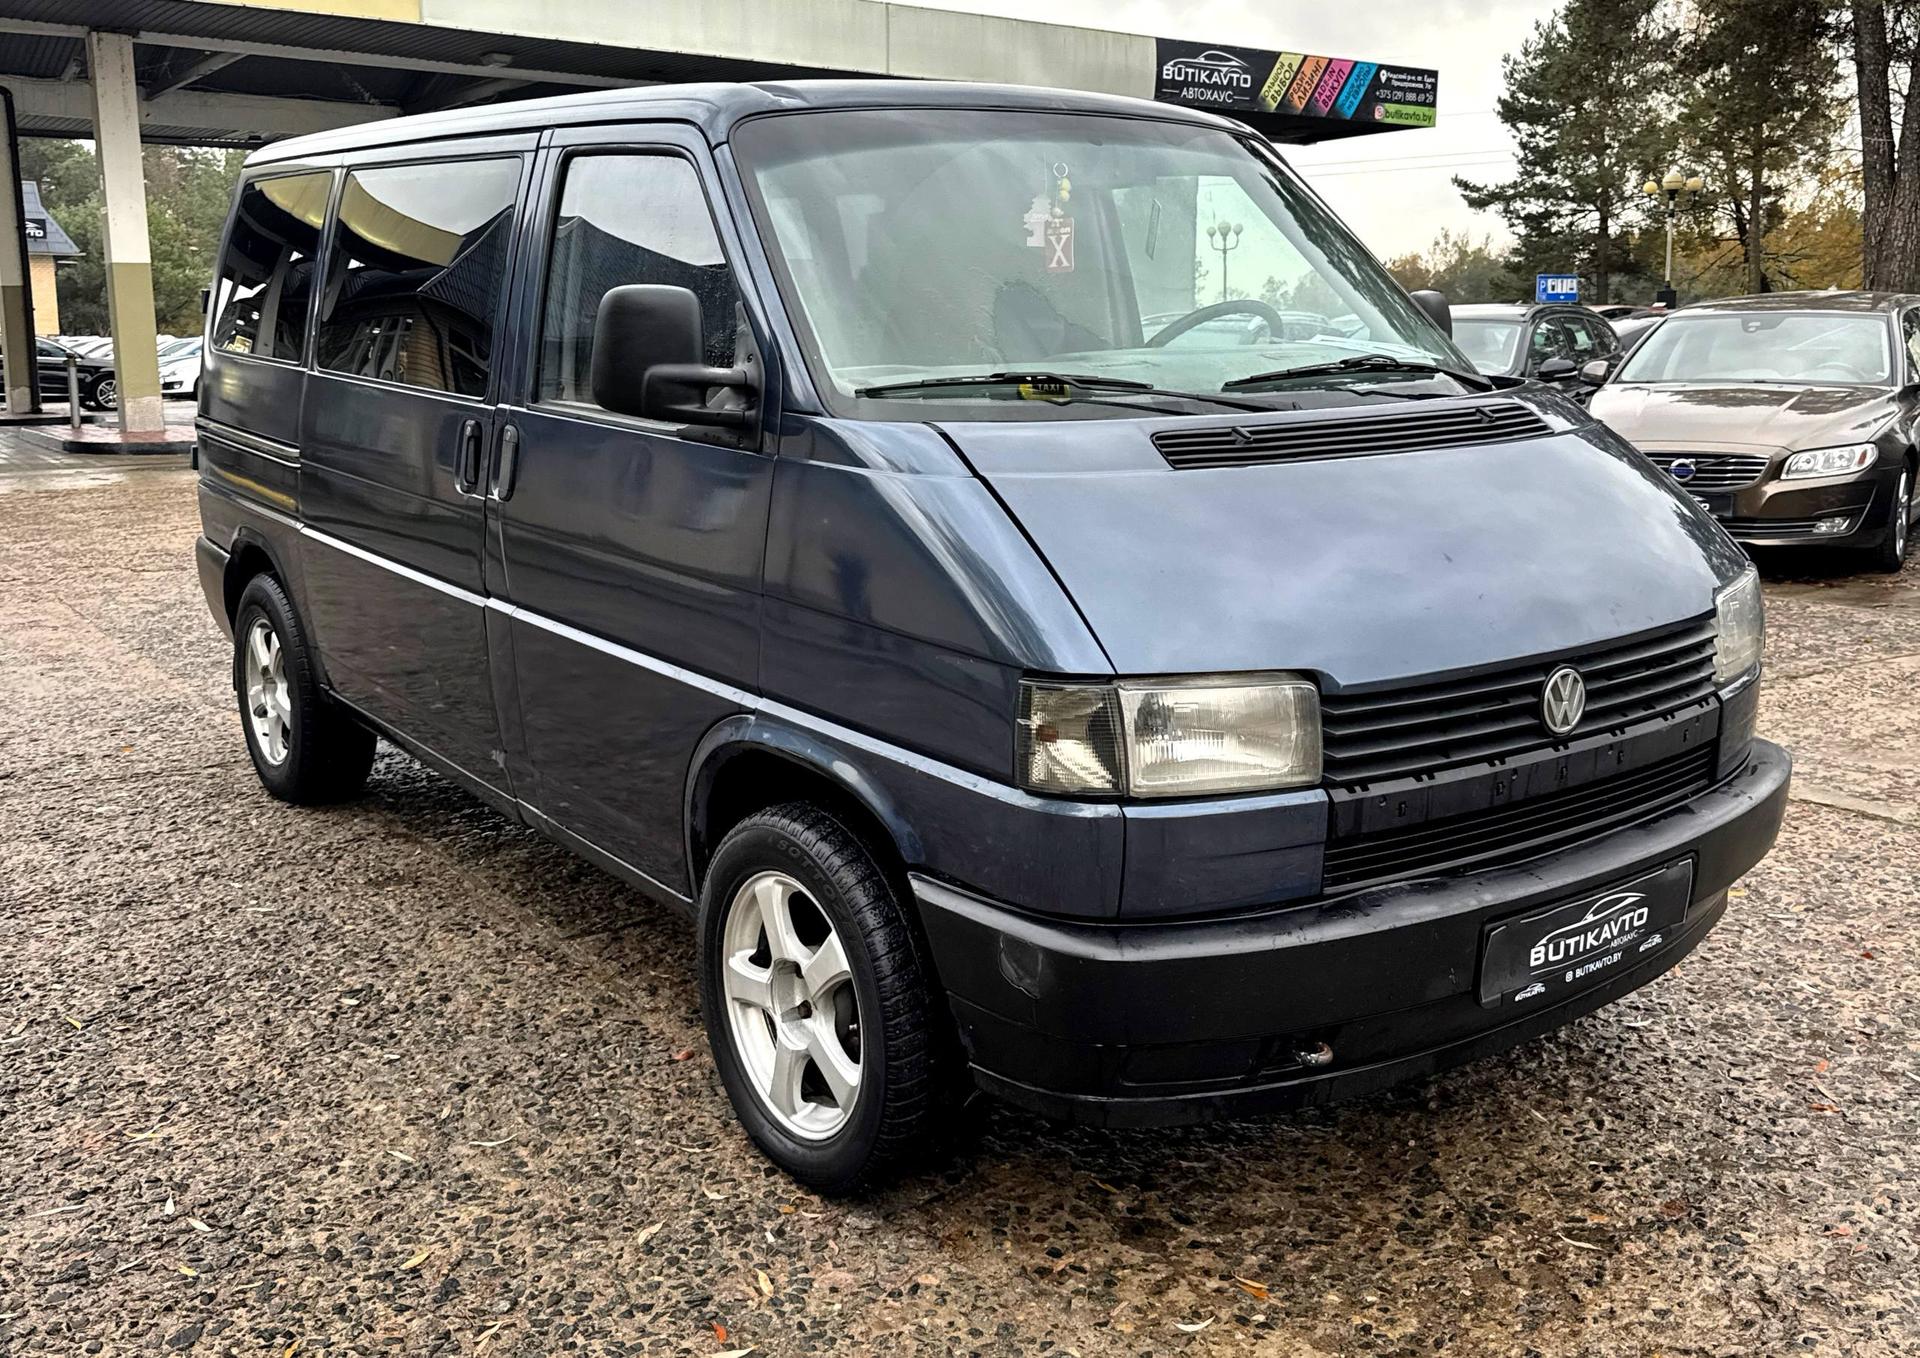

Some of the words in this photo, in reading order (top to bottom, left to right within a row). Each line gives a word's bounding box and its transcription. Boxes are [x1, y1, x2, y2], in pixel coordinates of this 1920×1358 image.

[1162, 65, 1251, 88] BUTIKAVTO
[1261, 60, 1285, 102] ОЛЬШОЙ
[1270, 62, 1294, 104] ВЫБОР
[1297, 60, 1322, 106] ЛИЗИНГ
[1321, 68, 1346, 109] ВЫКУП
[1180, 87, 1234, 103] АВТОХАУС
[1376, 89, 1391, 99] +375
[1392, 90, 1404, 102] (29)
[1385, 108, 1432, 124] butikavto.by
[1530, 907, 1648, 967] BUTIKAVTO
[1575, 951, 1622, 978] BUTIKAVTO.BY
